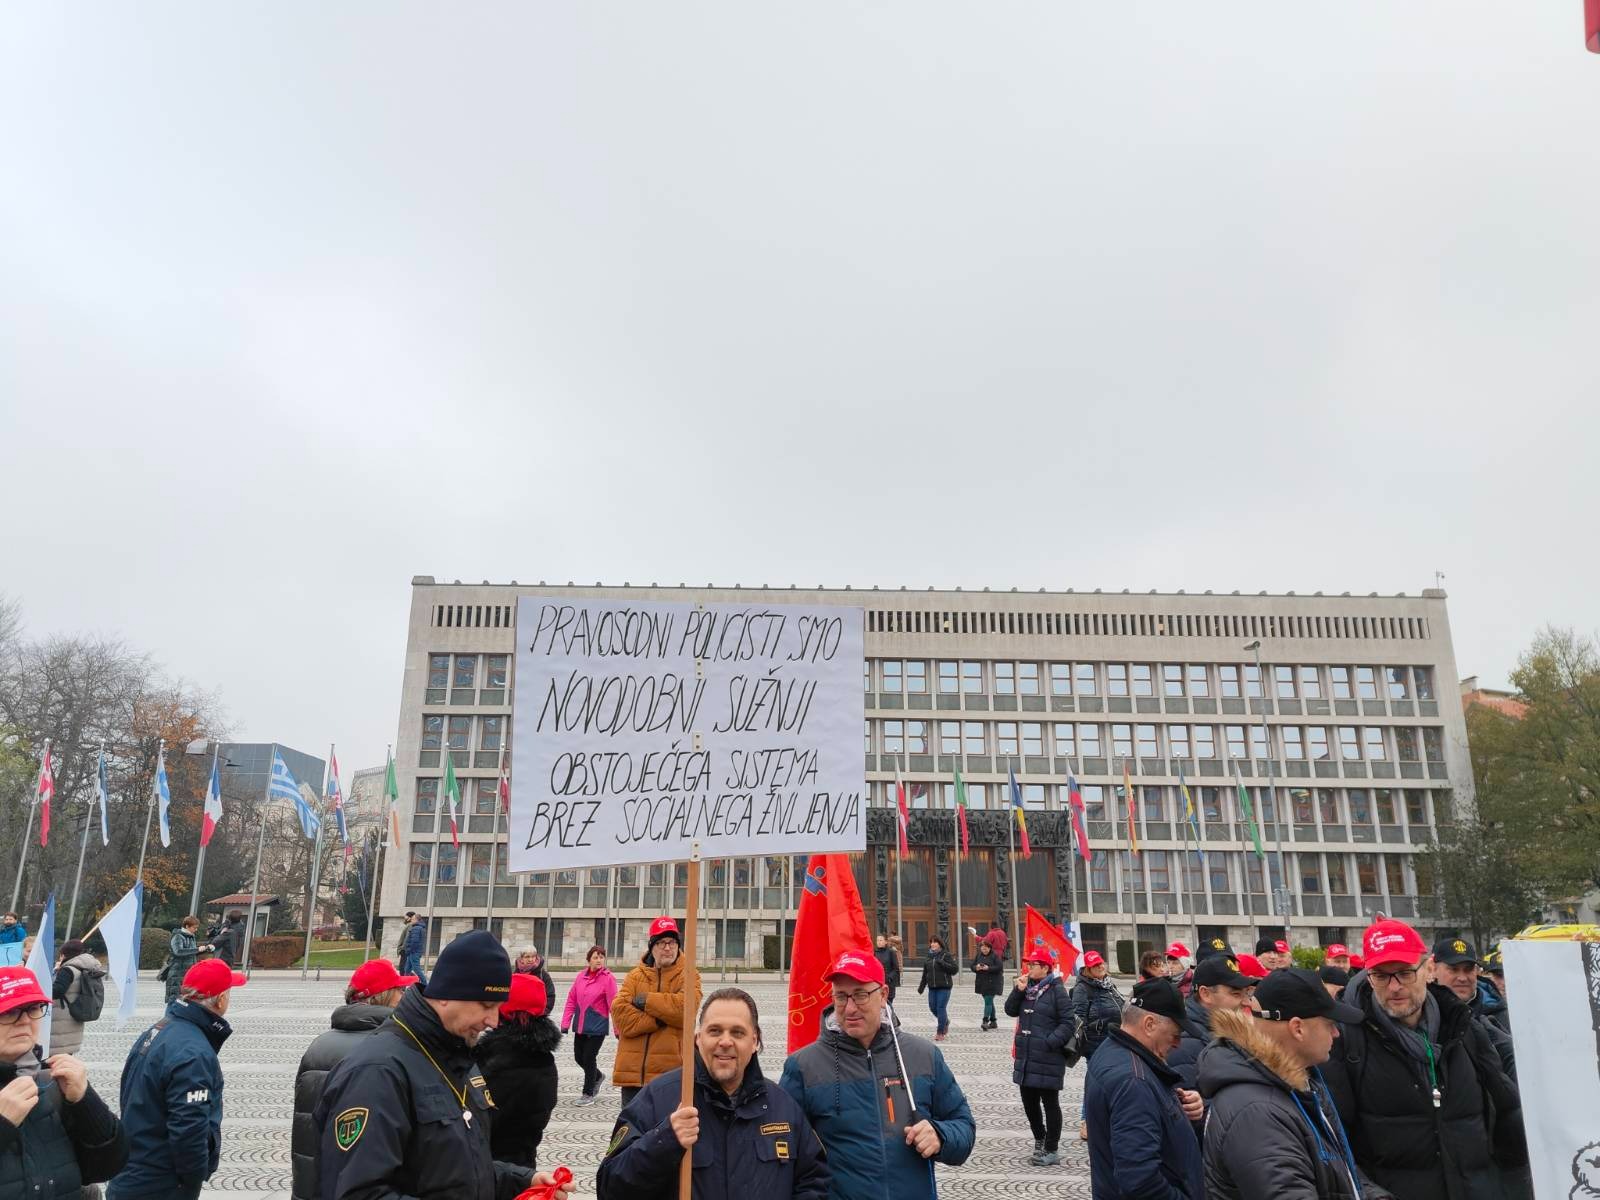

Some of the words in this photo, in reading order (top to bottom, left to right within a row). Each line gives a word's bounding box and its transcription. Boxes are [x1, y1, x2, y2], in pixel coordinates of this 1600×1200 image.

[787, 615, 843, 665] SMO
[536, 670, 707, 737] NOVODOBNI
[712, 665, 818, 736] SUŽNJI
[550, 740, 712, 796] OBSTOJEČEGA
[725, 748, 819, 791] SISTEMA
[525, 800, 602, 850] BREZ
[615, 791, 753, 845] SOCIALNEGA
[756, 785, 860, 836] ŽIVLJENJA
[186, 1089, 209, 1103] HH
